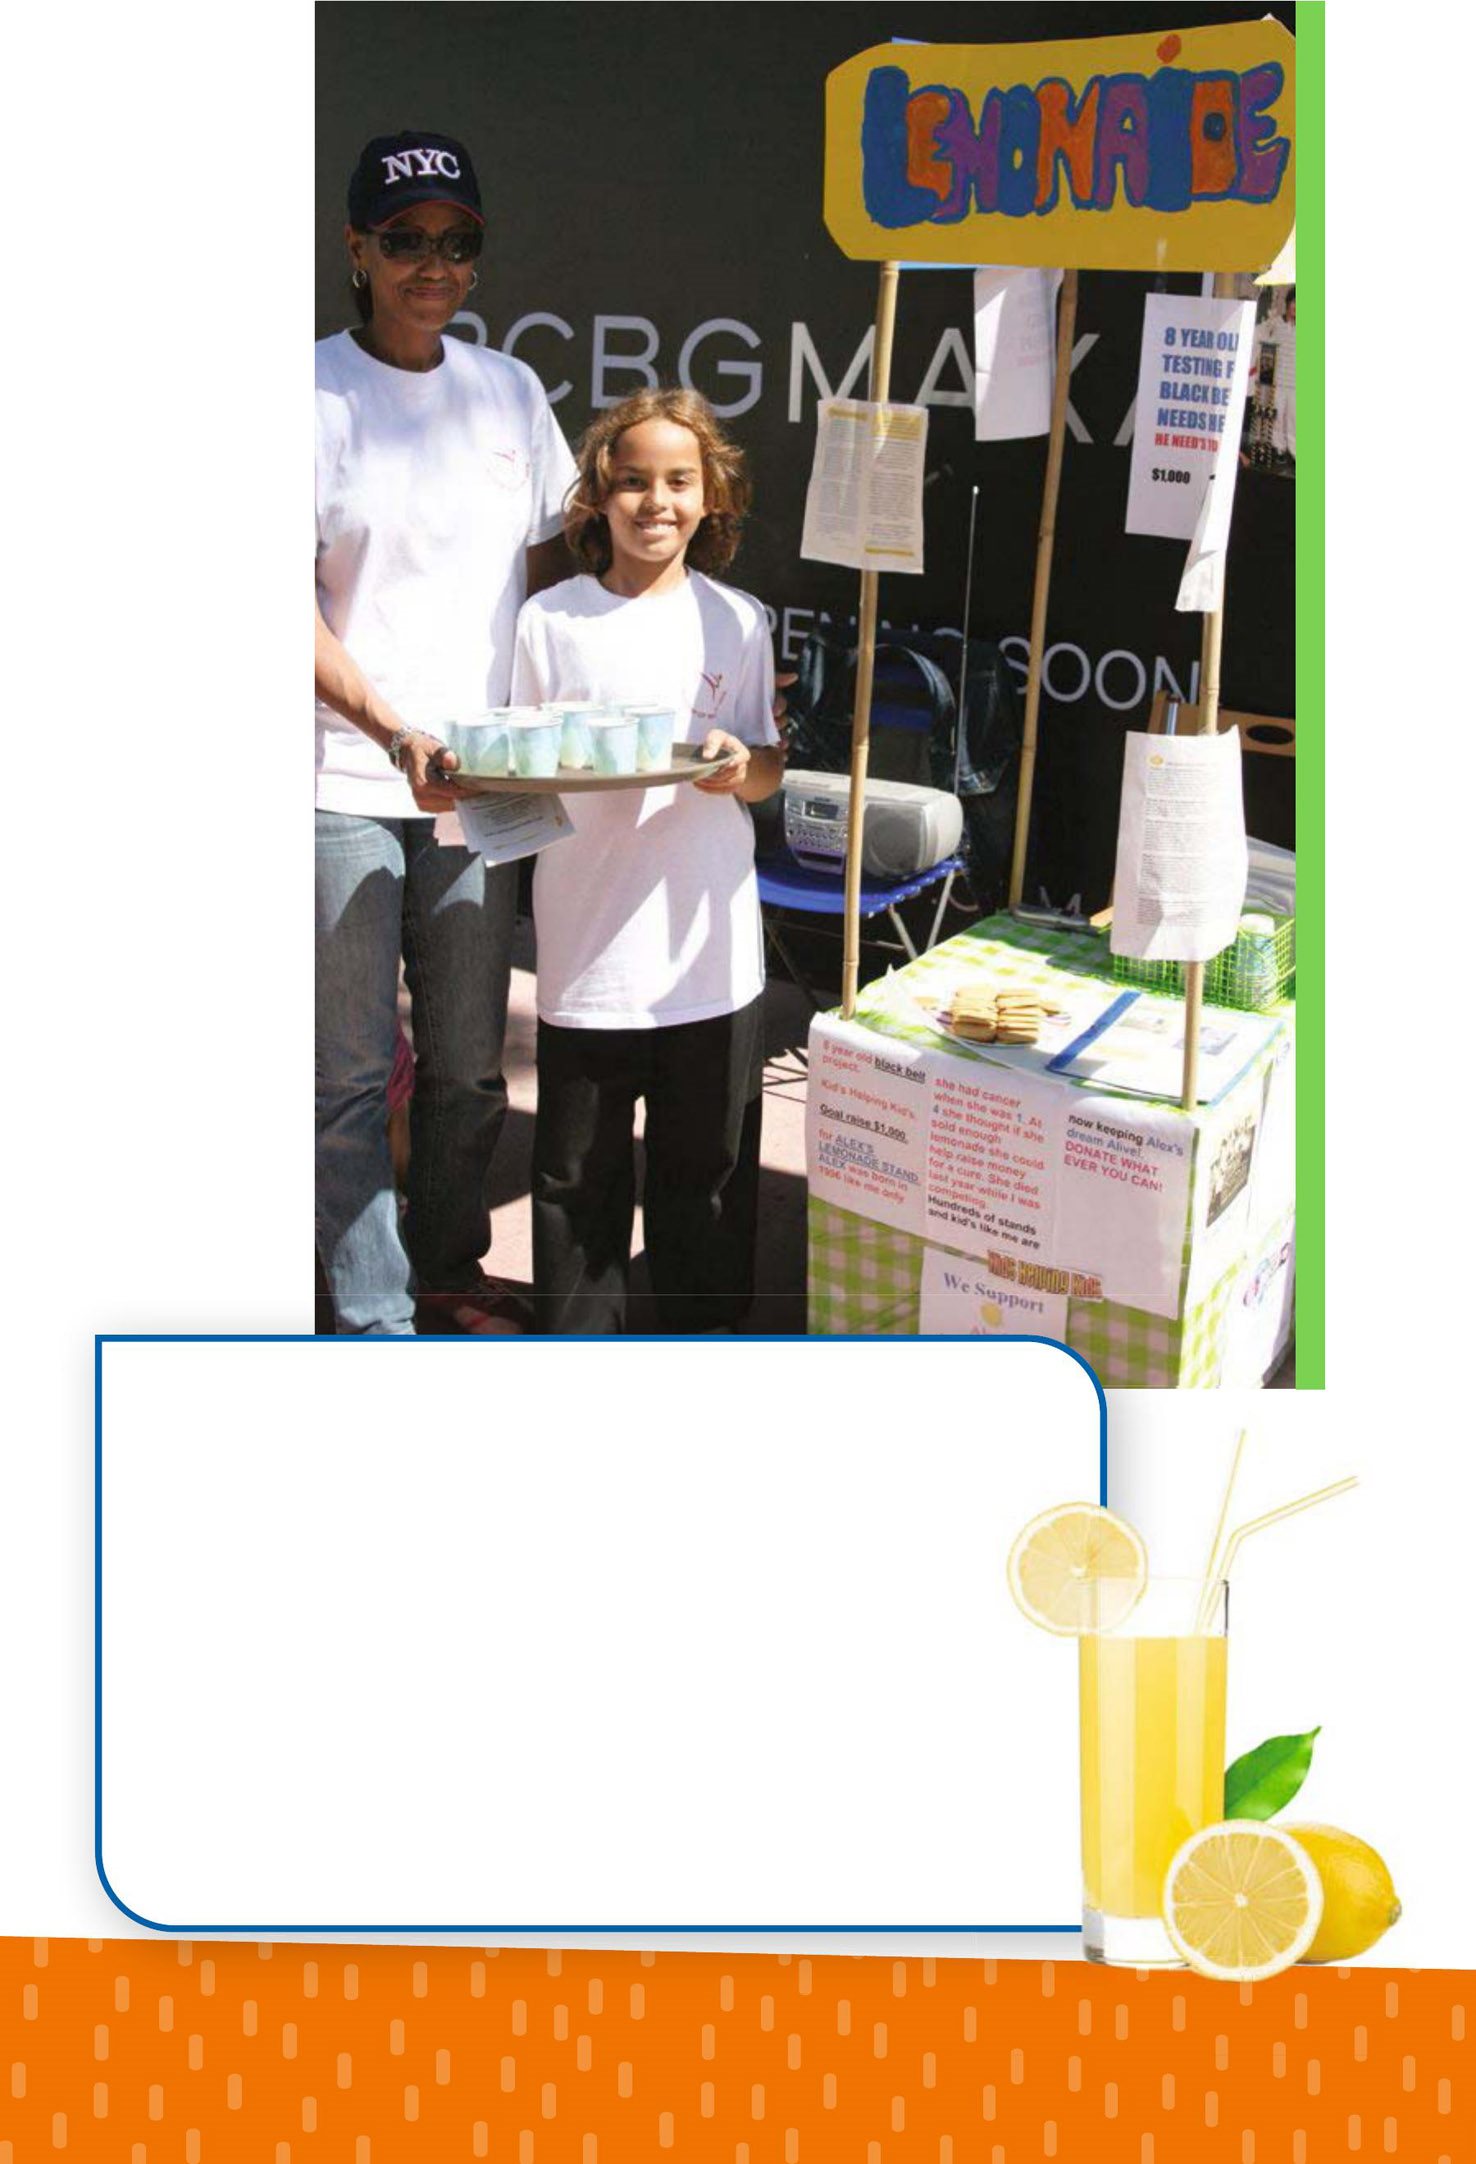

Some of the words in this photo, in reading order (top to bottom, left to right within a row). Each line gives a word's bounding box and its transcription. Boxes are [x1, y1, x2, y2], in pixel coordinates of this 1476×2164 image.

[381, 148, 461, 185] NYC
[1164, 326, 1176, 347] 8
[1180, 328, 1213, 349] YEAR
[1162, 354, 1223, 377] TESTING
[1160, 381, 1210, 405] BLACK
[1211, 387, 1230, 407] BE
[1157, 407, 1206, 430] NEEDS
[1154, 432, 1170, 447] HE
[999, 635, 1200, 711] SOON
[875, 1056, 903, 1073] black
[905, 1066, 926, 1081] belt
[934, 1092, 963, 1106] when
[967, 1101, 987, 1113] she
[990, 1108, 1012, 1120] was
[936, 1078, 955, 1090] she
[958, 1083, 979, 1097] had
[982, 1091, 1021, 1108] cancer
[820, 1103, 843, 1120] Goal
[846, 1113, 871, 1128] raise
[931, 1119, 956, 1133] sold
[959, 1126, 1001, 1145] enough
[942, 1107, 962, 1120] she
[965, 1113, 1011, 1133] thought
[1013, 1125, 1021, 1136] if
[1023, 1131, 1044, 1143] she
[930, 1131, 985, 1153] lemonade
[988, 1147, 1009, 1160] she
[1012, 1153, 1044, 1170] could
[1066, 1128, 1103, 1146] dream
[1069, 1114, 1093, 1129] now
[1096, 1121, 1143, 1146] keeping
[1146, 1136, 1183, 1156] Alex's
[818, 1141, 880, 1168] LEMONADE
[818, 1153, 846, 1169] ALEX
[848, 1165, 869, 1178] was
[871, 1171, 896, 1187] born
[898, 1181, 908, 1191] in
[929, 1145, 953, 1159] help
[957, 1153, 984, 1167] raise
[987, 1161, 1026, 1179] money
[1065, 1140, 1117, 1165] DONATE
[1121, 1157, 1159, 1176] WHAT
[929, 1157, 944, 1168] for
[987, 1173, 1010, 1187] She
[1013, 1181, 1039, 1195] died
[929, 1170, 948, 1183] last
[951, 1179, 974, 1191] year
[978, 1186, 1008, 1200] while
[1018, 1197, 1040, 1209] was
[1064, 1153, 1097, 1173] EVER
[1101, 1165, 1127, 1181] YOU
[1131, 1175, 1163, 1193] CAN!
[928, 1194, 980, 1218] Hundreds
[984, 1213, 995, 1223] of
[999, 1218, 1036, 1235] stands
[928, 1208, 948, 1220] and
[951, 1213, 976, 1229] kid's
[980, 1223, 998, 1236] like
[1001, 1232, 1018, 1243] me
[1021, 1238, 1040, 1249] are
[943, 1271, 970, 1294] We
[974, 1280, 1044, 1314] Support
